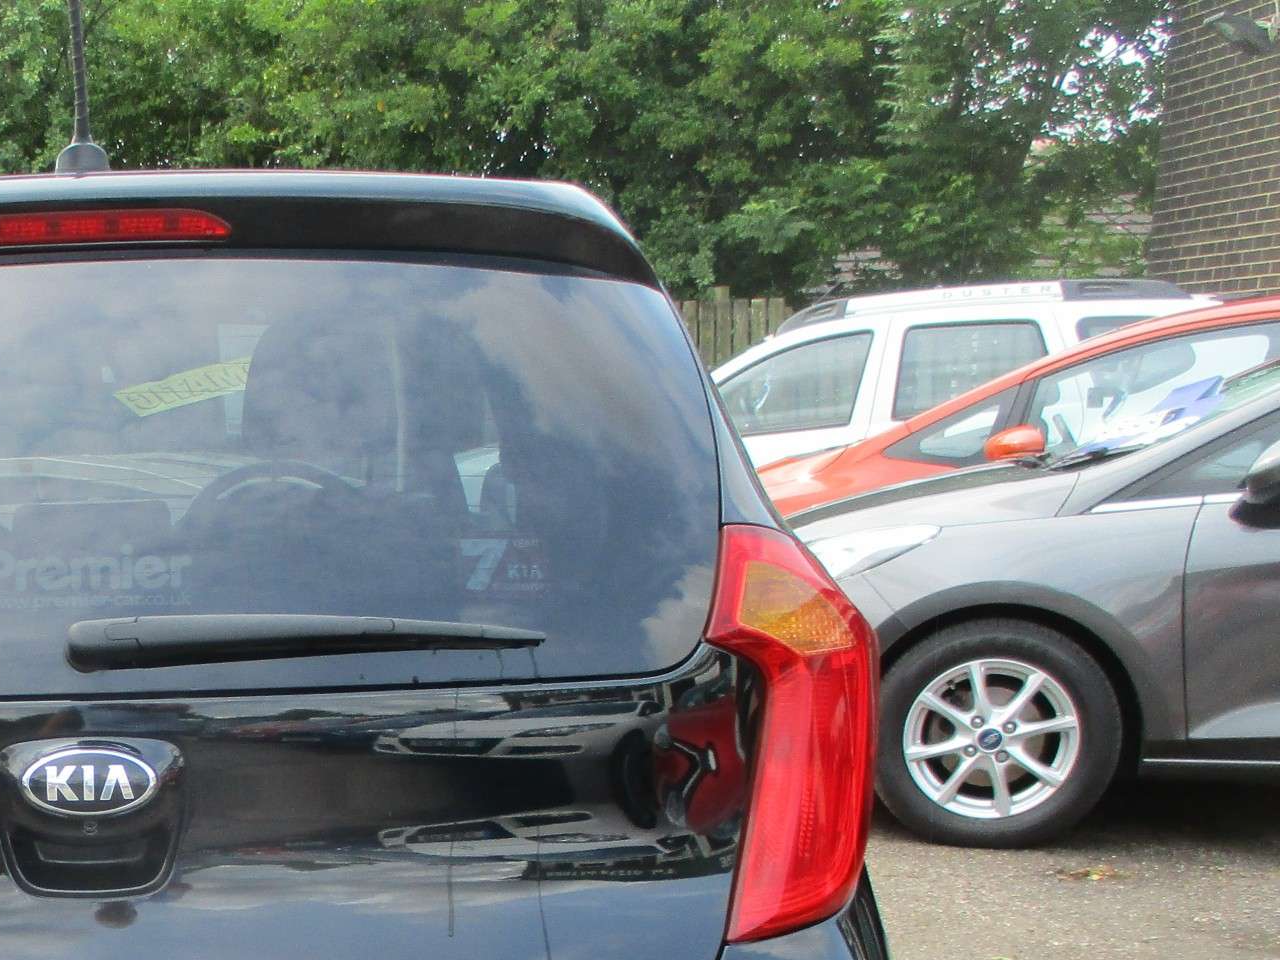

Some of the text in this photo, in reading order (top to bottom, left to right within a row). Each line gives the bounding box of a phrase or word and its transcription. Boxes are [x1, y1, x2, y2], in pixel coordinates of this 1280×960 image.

[942, 285, 1052, 299] DUSTER
[460, 539, 508, 591] 7
[45, 764, 135, 802] KIA
